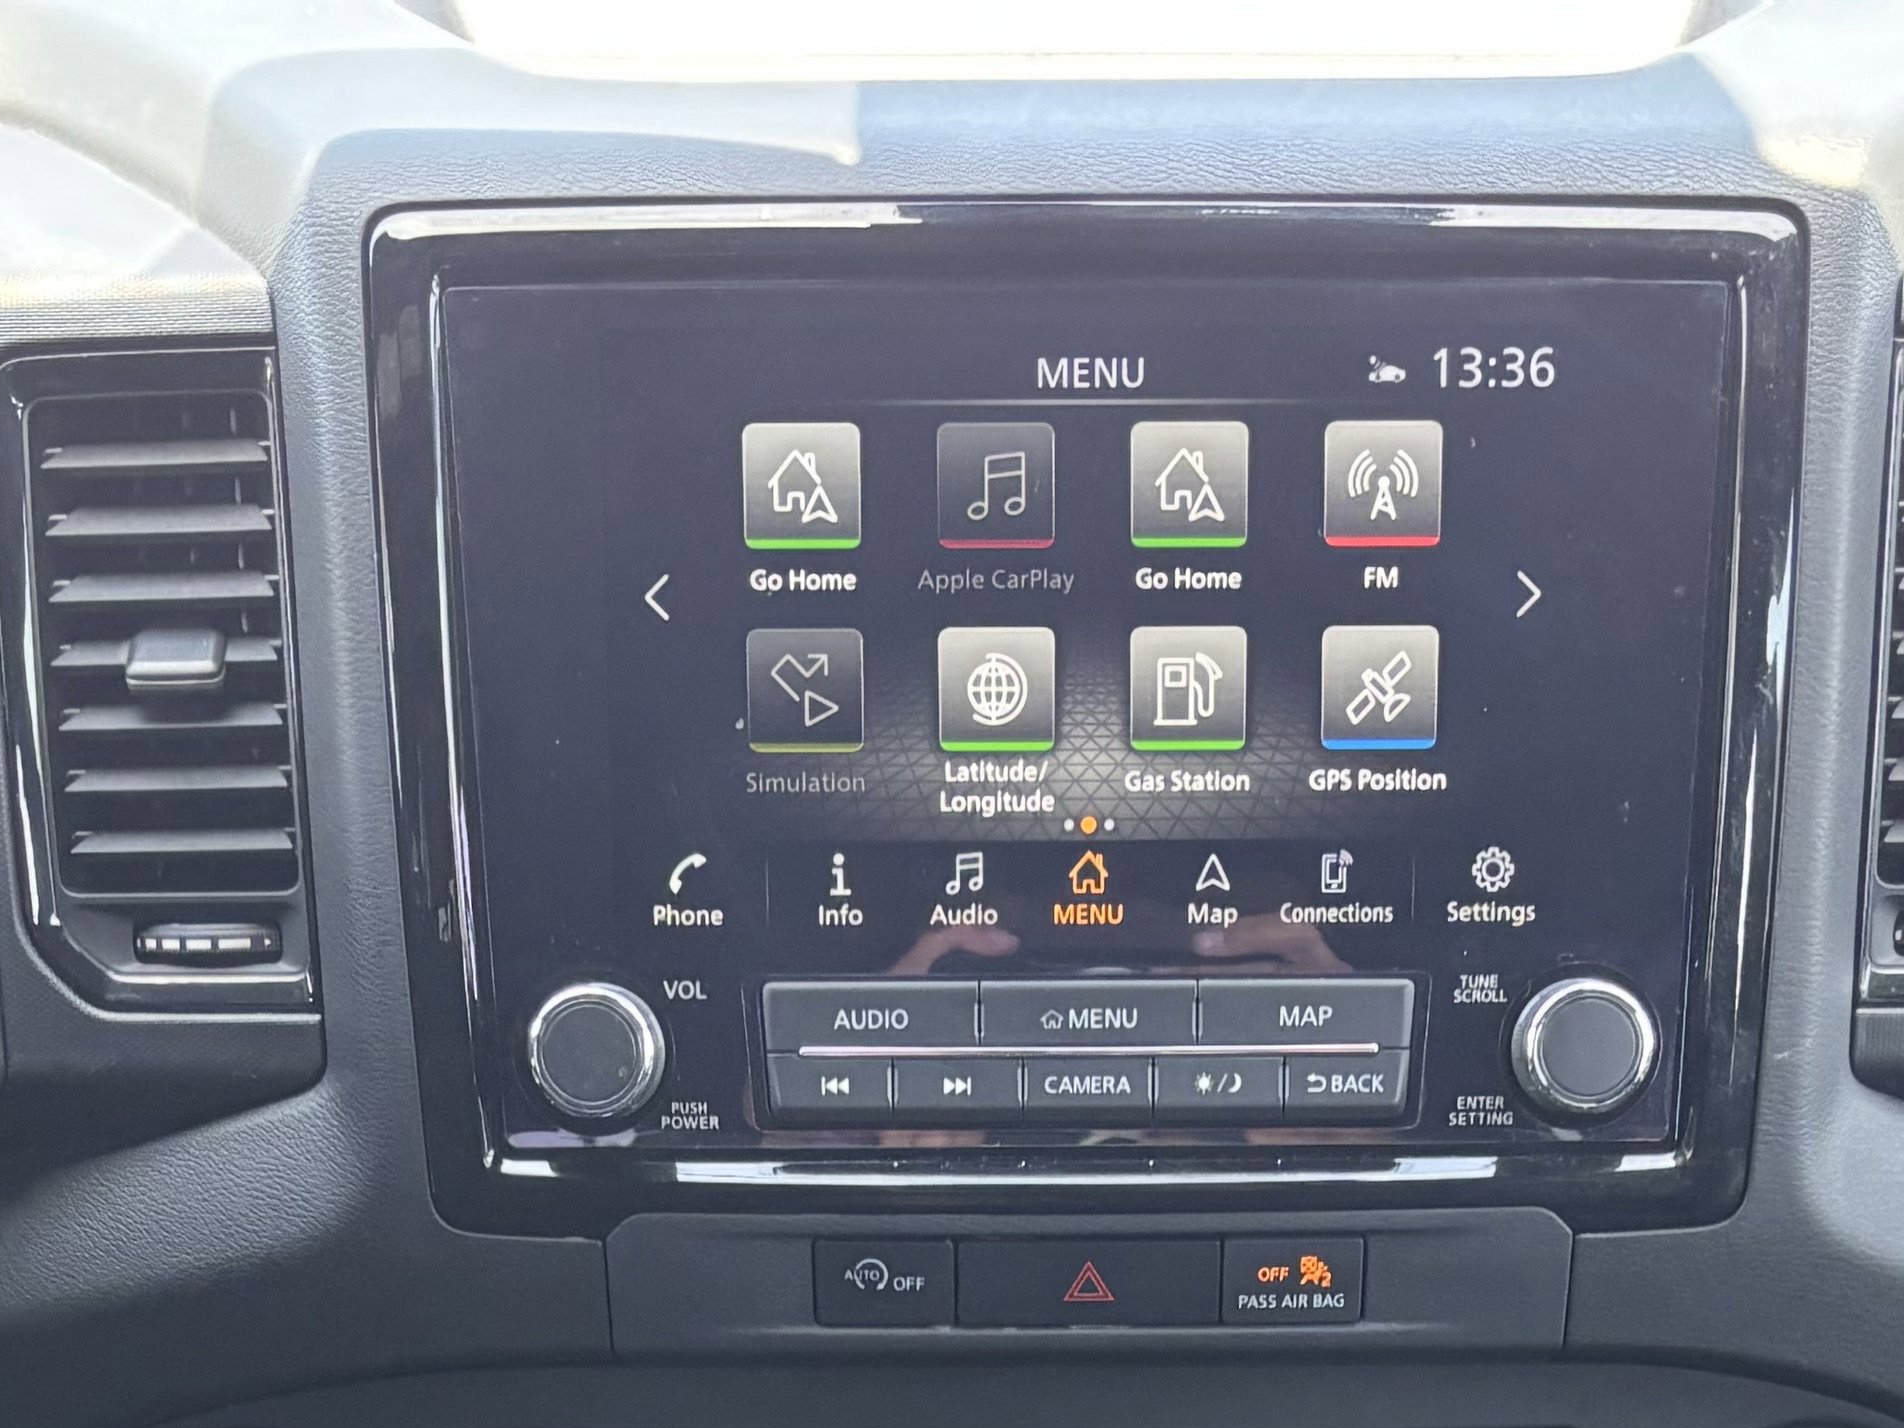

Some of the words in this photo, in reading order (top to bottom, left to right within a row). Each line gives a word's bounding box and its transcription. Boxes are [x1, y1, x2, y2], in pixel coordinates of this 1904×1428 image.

[1036, 356, 1145, 390] MENU
[1432, 349, 1555, 388] 13:36
[749, 569, 781, 592] Go
[788, 569, 856, 592] Home
[918, 569, 984, 596] Apple
[987, 567, 1074, 596] CarPlay
[1135, 567, 1166, 590] Go
[1173, 567, 1241, 590] Home
[1364, 566, 1398, 588] FM
[745, 771, 865, 794] Simulation
[944, 760, 1048, 785] Latitude/
[1124, 769, 1165, 793] Gas
[1171, 769, 1249, 793] Station
[1309, 768, 1353, 792] GPS
[1360, 768, 1446, 792] Position
[940, 791, 1054, 817] Longitude
[653, 903, 723, 926] Phone
[818, 903, 863, 926] Info
[930, 903, 999, 926] Audio
[1052, 903, 1124, 925] MENU
[1187, 902, 1237, 930] Map
[1280, 901, 1393, 924] Connections
[1446, 900, 1535, 926] Settings
[664, 980, 707, 1000] VOL
[1460, 975, 1497, 989] TUNE
[1454, 990, 1507, 1004] SCROLL
[833, 1008, 908, 1031] AUDIO
[1068, 1008, 1138, 1030] MENU
[1279, 1005, 1332, 1028] MAP
[1043, 1074, 1131, 1095] CAMERA
[1322, 1074, 1384, 1094] BACK
[672, 1101, 708, 1115] PUSH
[1456, 1097, 1504, 1111] ENTER
[661, 1115, 720, 1131] POWER
[1448, 1112, 1513, 1127] SETTING
[893, 1276, 924, 1291] OFF
[1257, 1267, 1289, 1282] OFF
[1238, 1293, 1277, 1310] PASS
[1281, 1293, 1308, 1310] AIR
[1313, 1293, 1345, 1310] BAG
